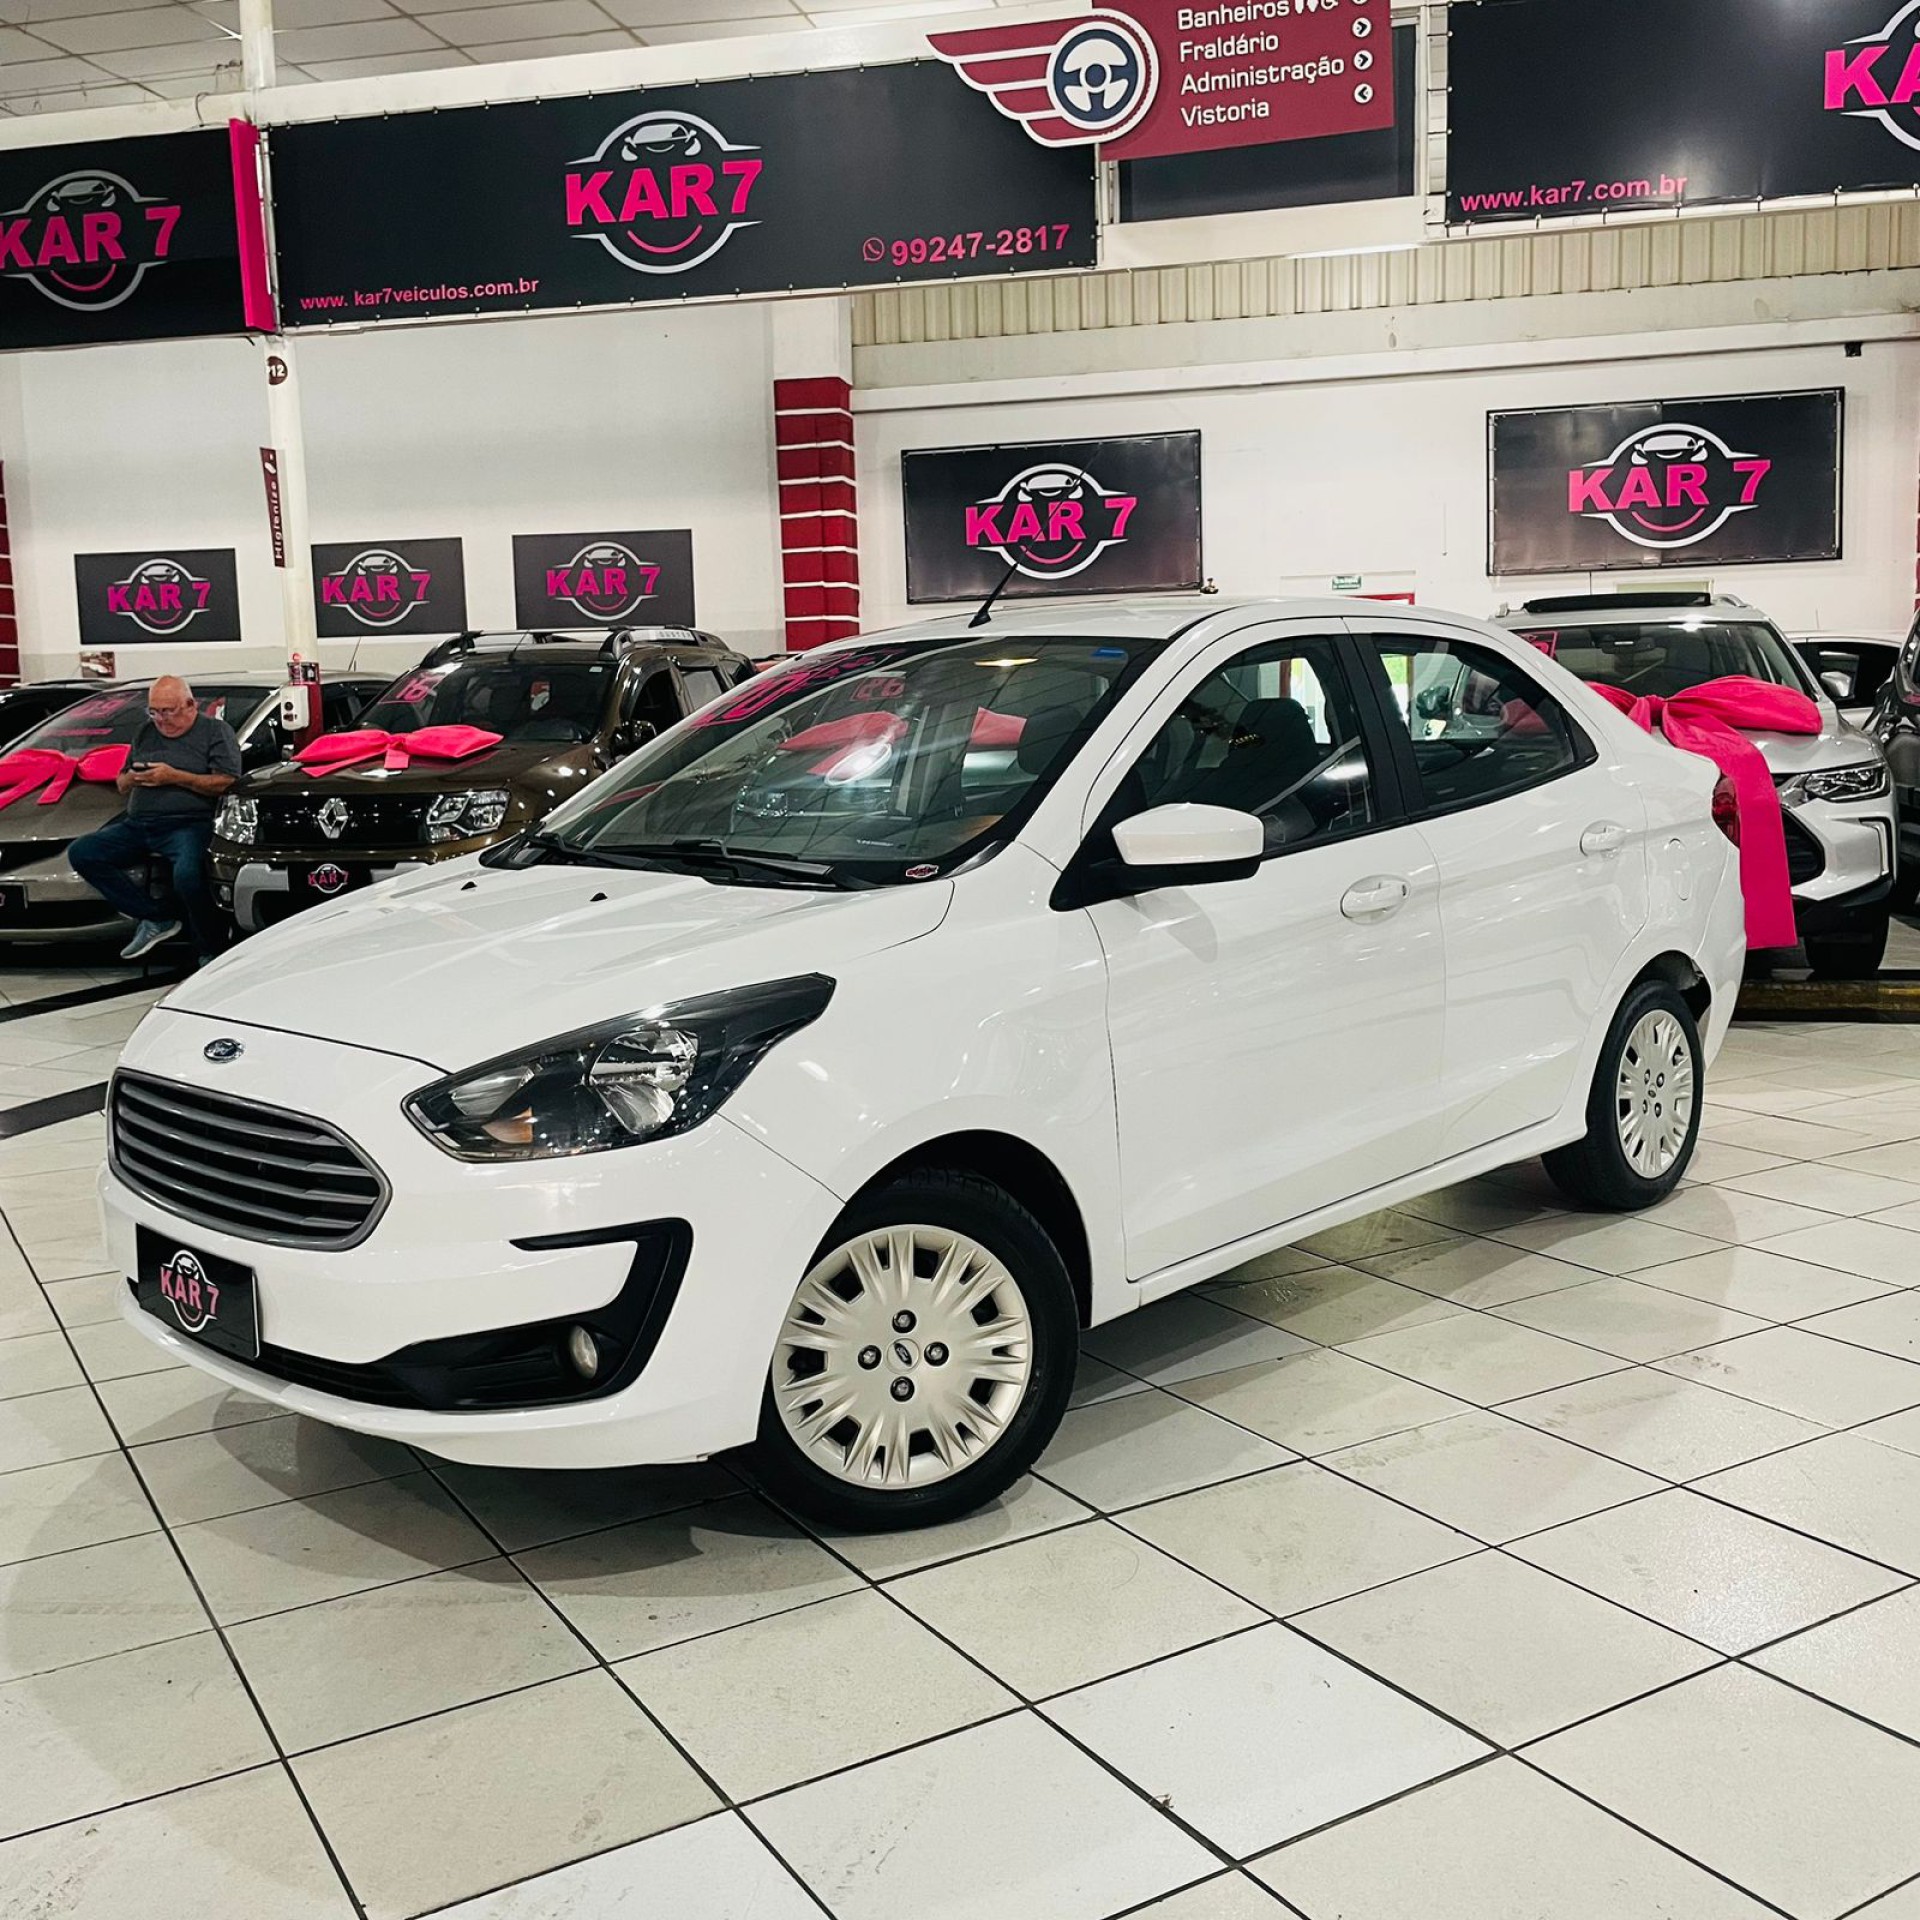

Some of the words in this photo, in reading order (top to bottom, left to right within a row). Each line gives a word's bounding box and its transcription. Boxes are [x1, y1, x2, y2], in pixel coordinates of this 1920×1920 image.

[1177, 0, 1290, 31] Banheiros
[1179, 31, 1279, 62] Fraldário
[1180, 55, 1345, 95] Administração
[1180, 98, 1270, 127] Vistoria
[1460, 173, 1688, 212] www.kar7.com.br
[0, 211, 125, 270] KAR
[145, 205, 182, 258] 7
[890, 223, 1070, 267] 99247-2817
[1568, 462, 1710, 513] KAR
[1732, 459, 1773, 504] 7
[964, 499, 1088, 547] KAR
[1104, 496, 1139, 539] 7
[107, 582, 184, 614] KAR
[191, 581, 212, 610] 7
[321, 574, 402, 604] KAR
[410, 572, 431, 602] 7
[545, 567, 630, 598] KAR
[639, 566, 662, 595] 7
[308, 871, 338, 886] KAR
[342, 871, 349, 885] 7
[160, 1265, 203, 1311] KAR
[206, 1284, 220, 1316] 7
